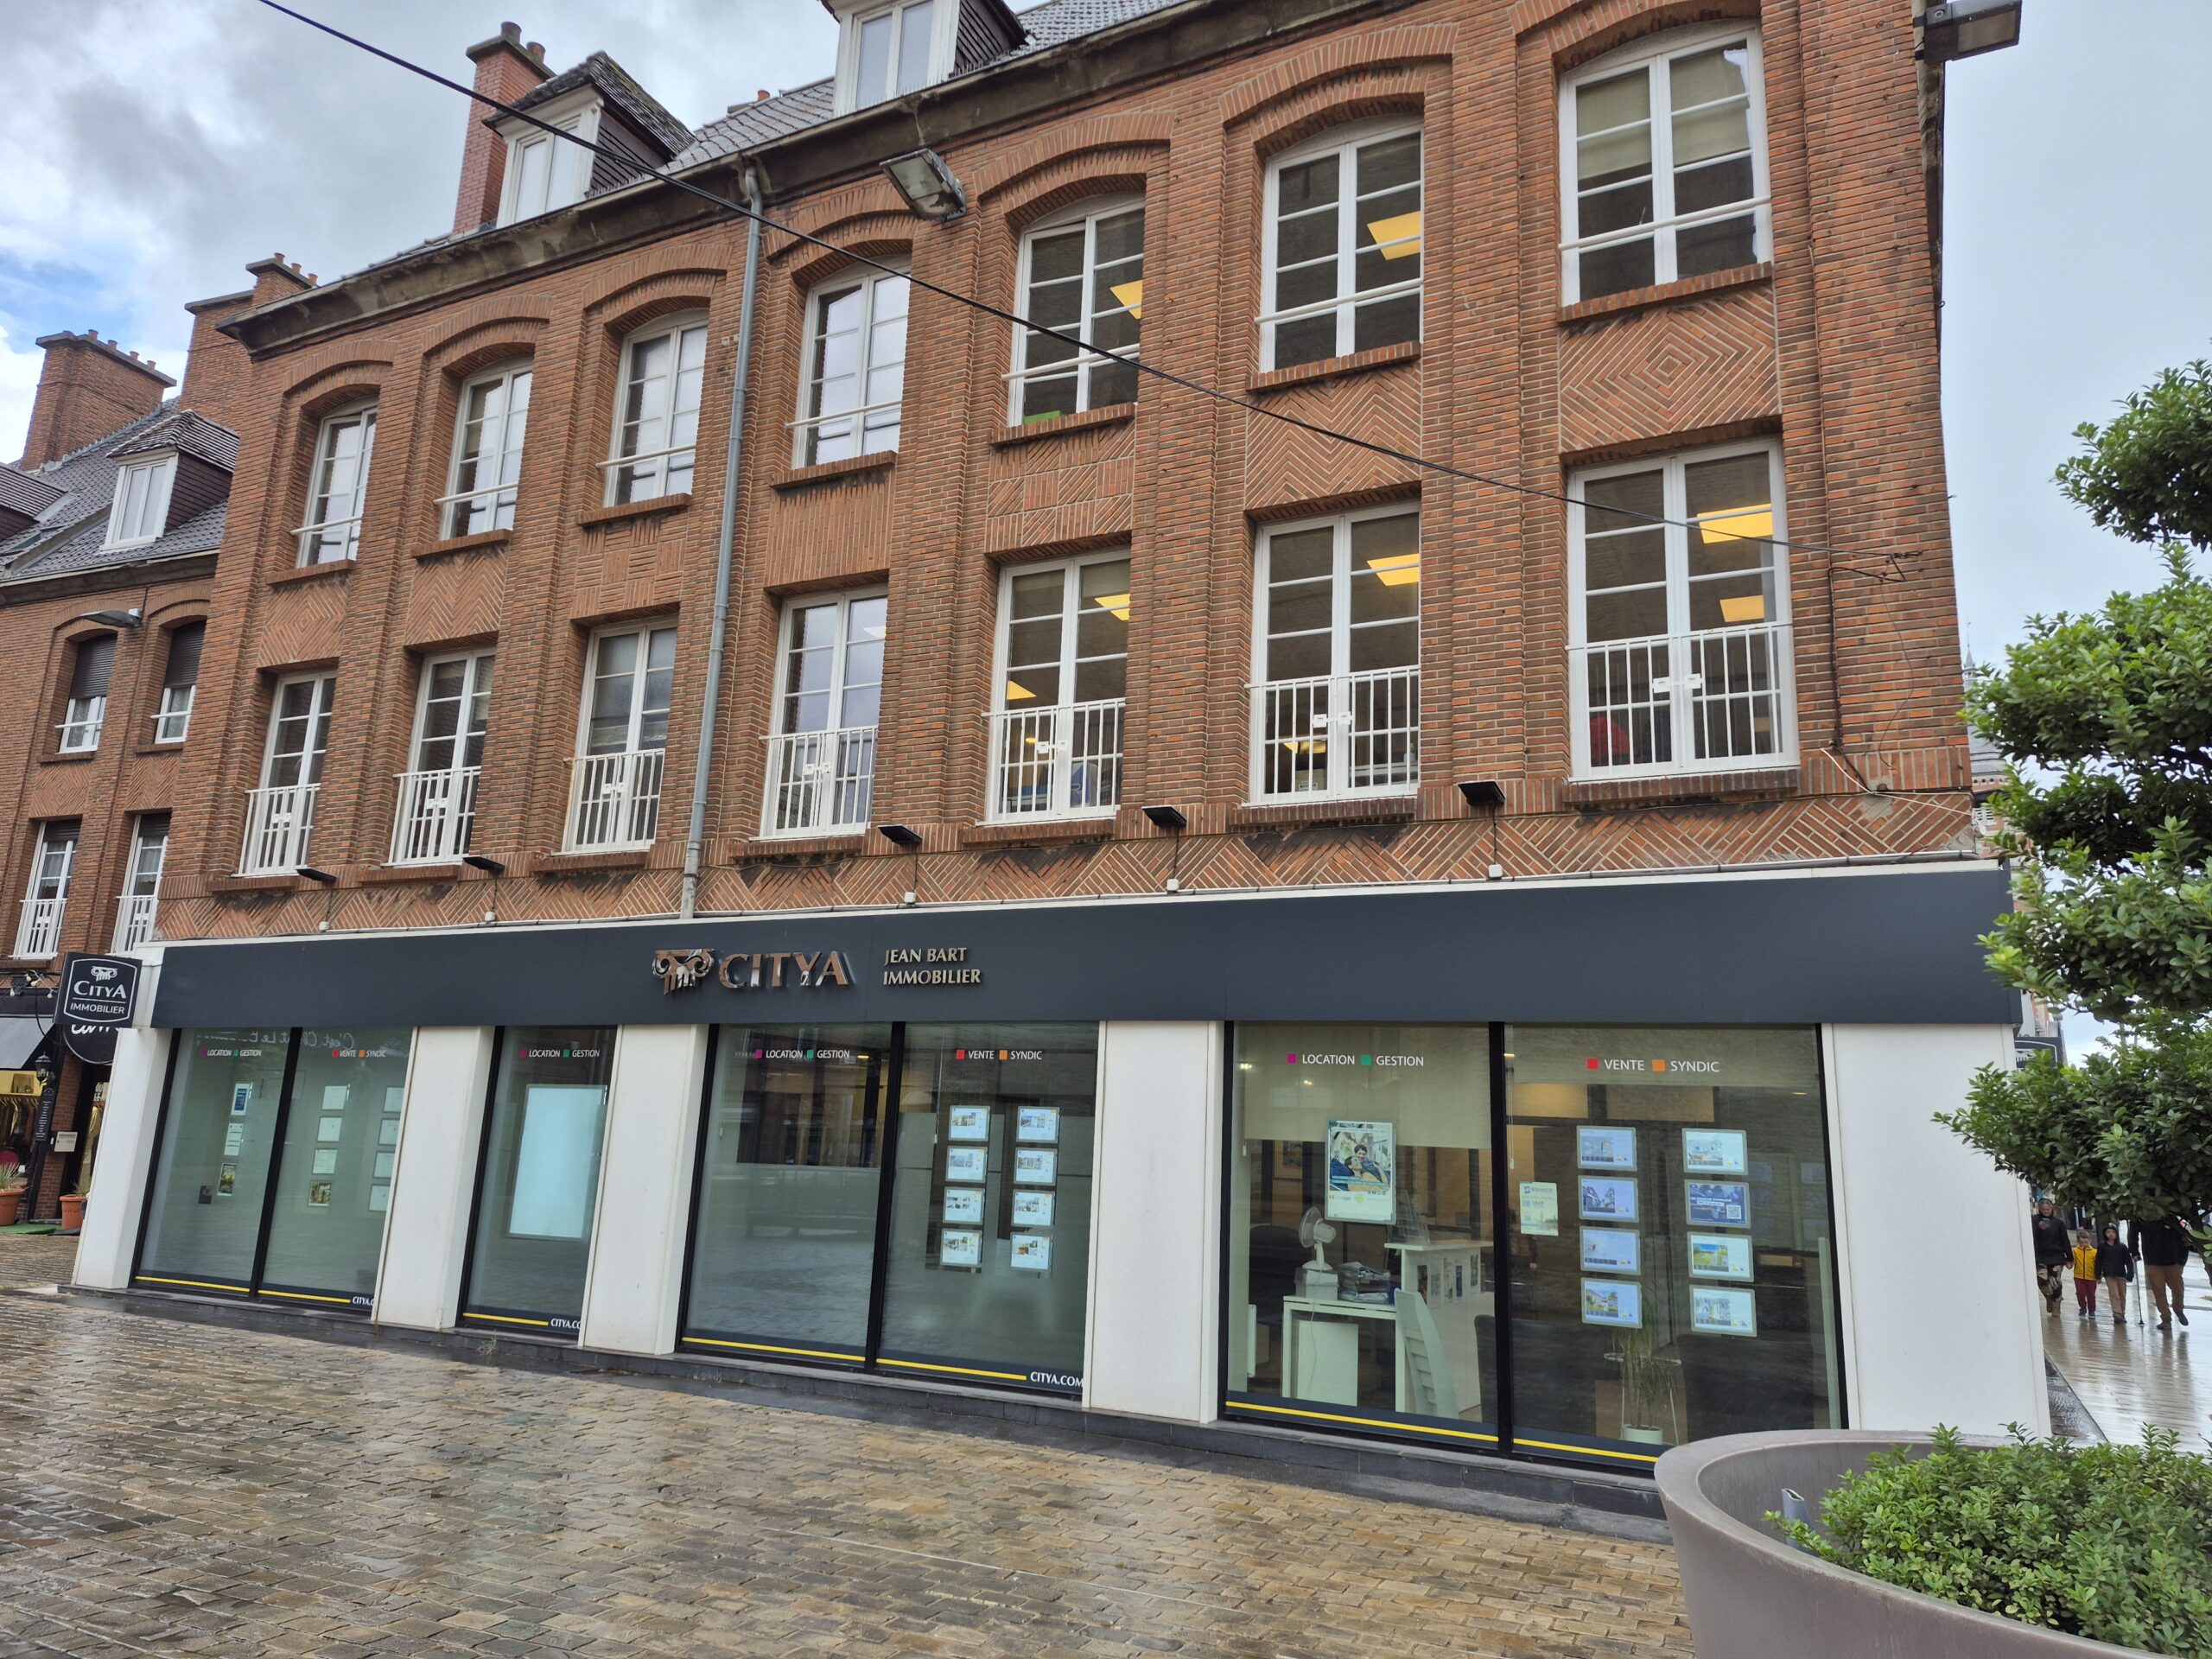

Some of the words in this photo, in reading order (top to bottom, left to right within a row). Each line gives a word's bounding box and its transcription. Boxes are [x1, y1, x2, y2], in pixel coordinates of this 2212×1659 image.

[884, 949, 922, 966] JEAN
[926, 947, 967, 962] BART
[718, 950, 849, 988] CITYA
[883, 969, 981, 985] IMMOBILIER
[70, 1002, 125, 1014] IMMOBILIER
[528, 1049, 561, 1058] LOCATION
[572, 1049, 601, 1058] GESTION
[766, 1049, 804, 1058] LOCATION
[817, 1049, 850, 1058] GESTION
[968, 1050, 995, 1059] VENTE
[1010, 1050, 1043, 1060] SYNDIC
[1302, 1053, 1355, 1065] LOCATION
[1376, 1055, 1424, 1066] GESTION
[1604, 1058, 1645, 1071] VENTE
[1670, 1060, 1719, 1072] SYNDIC
[1030, 1371, 1084, 1388] CITYA.COM
